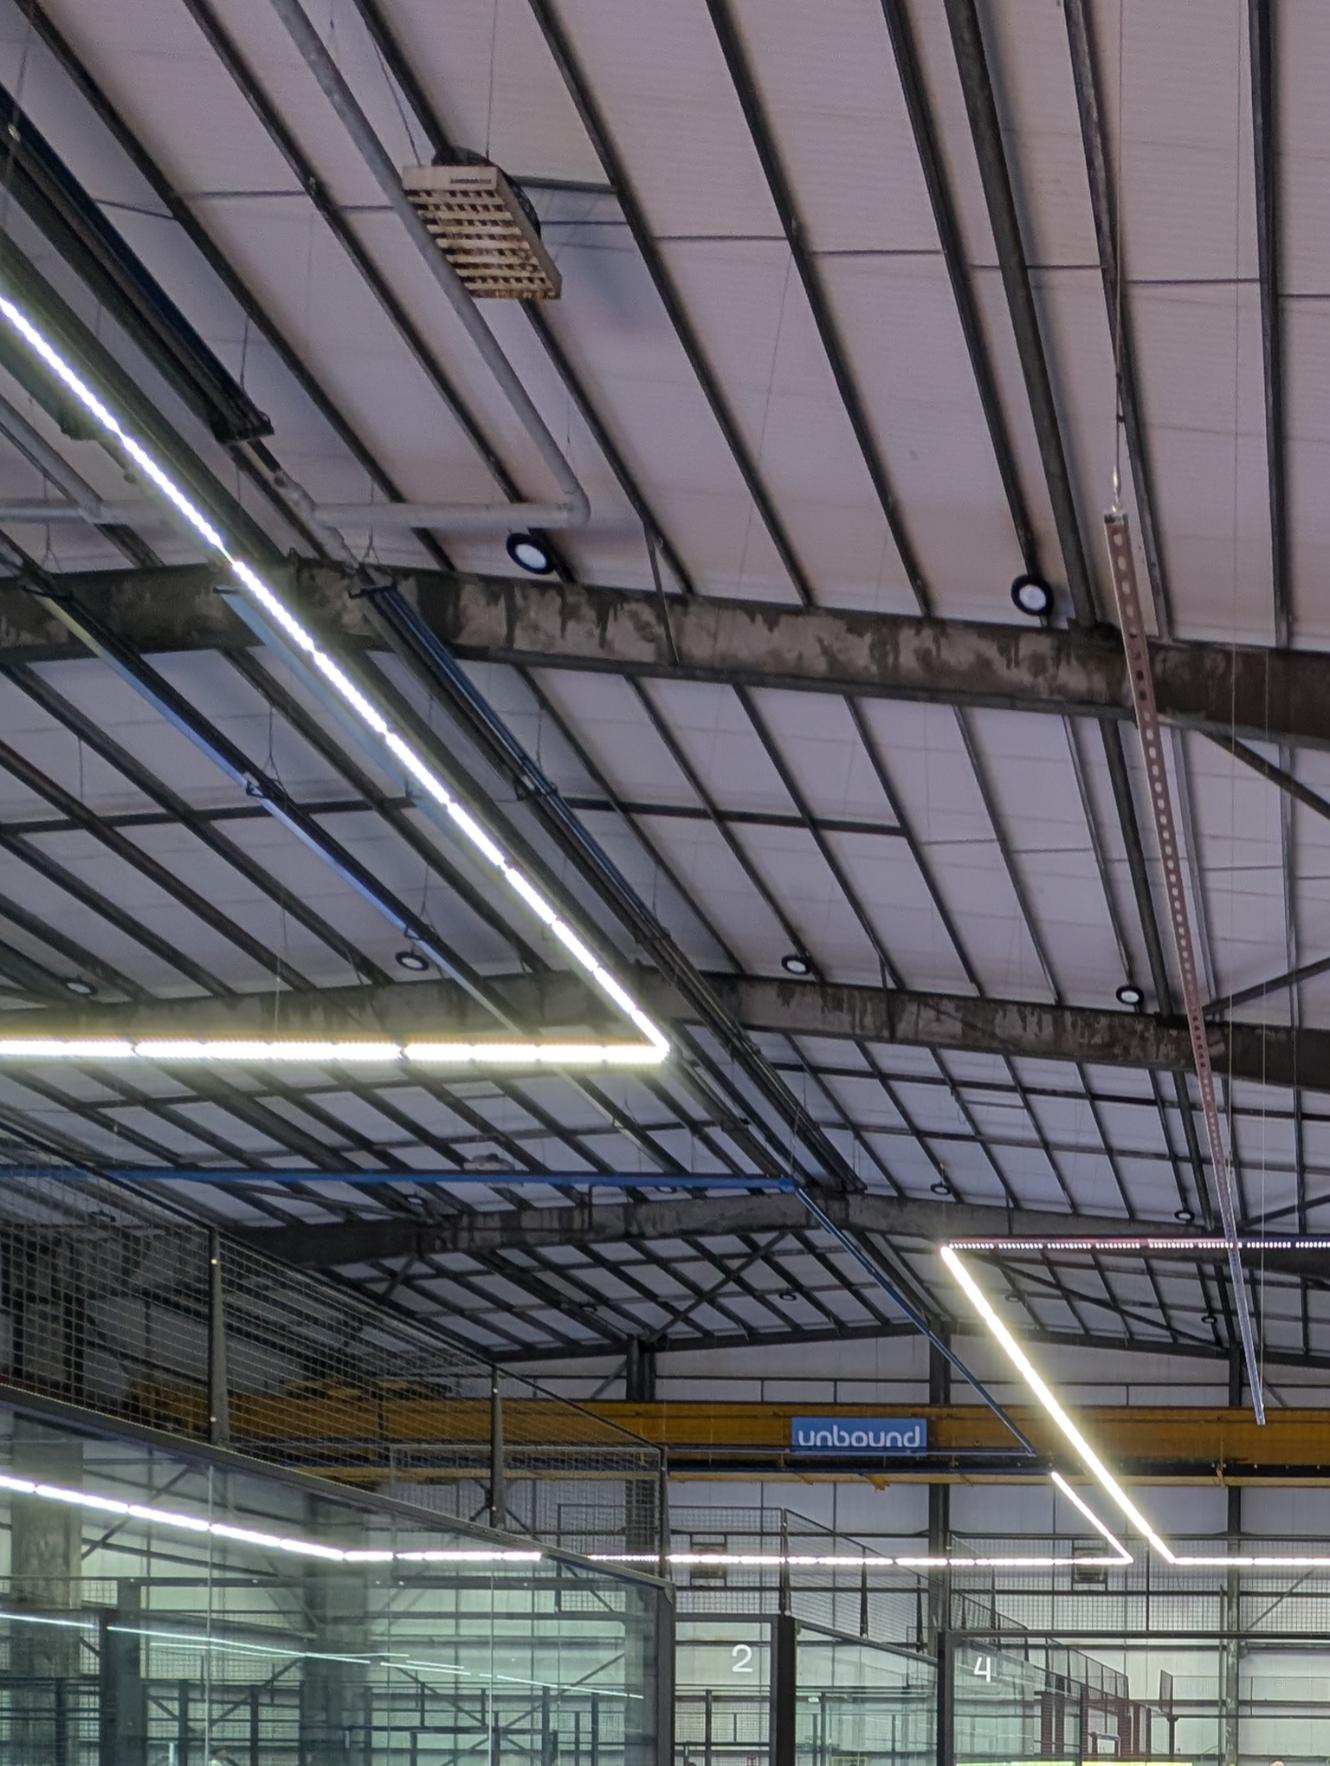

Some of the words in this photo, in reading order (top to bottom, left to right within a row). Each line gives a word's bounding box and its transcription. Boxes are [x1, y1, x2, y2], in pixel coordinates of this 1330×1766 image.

[798, 1424, 920, 1448] unbound
[731, 1644, 753, 1673] 2
[973, 1656, 992, 1683] 4
